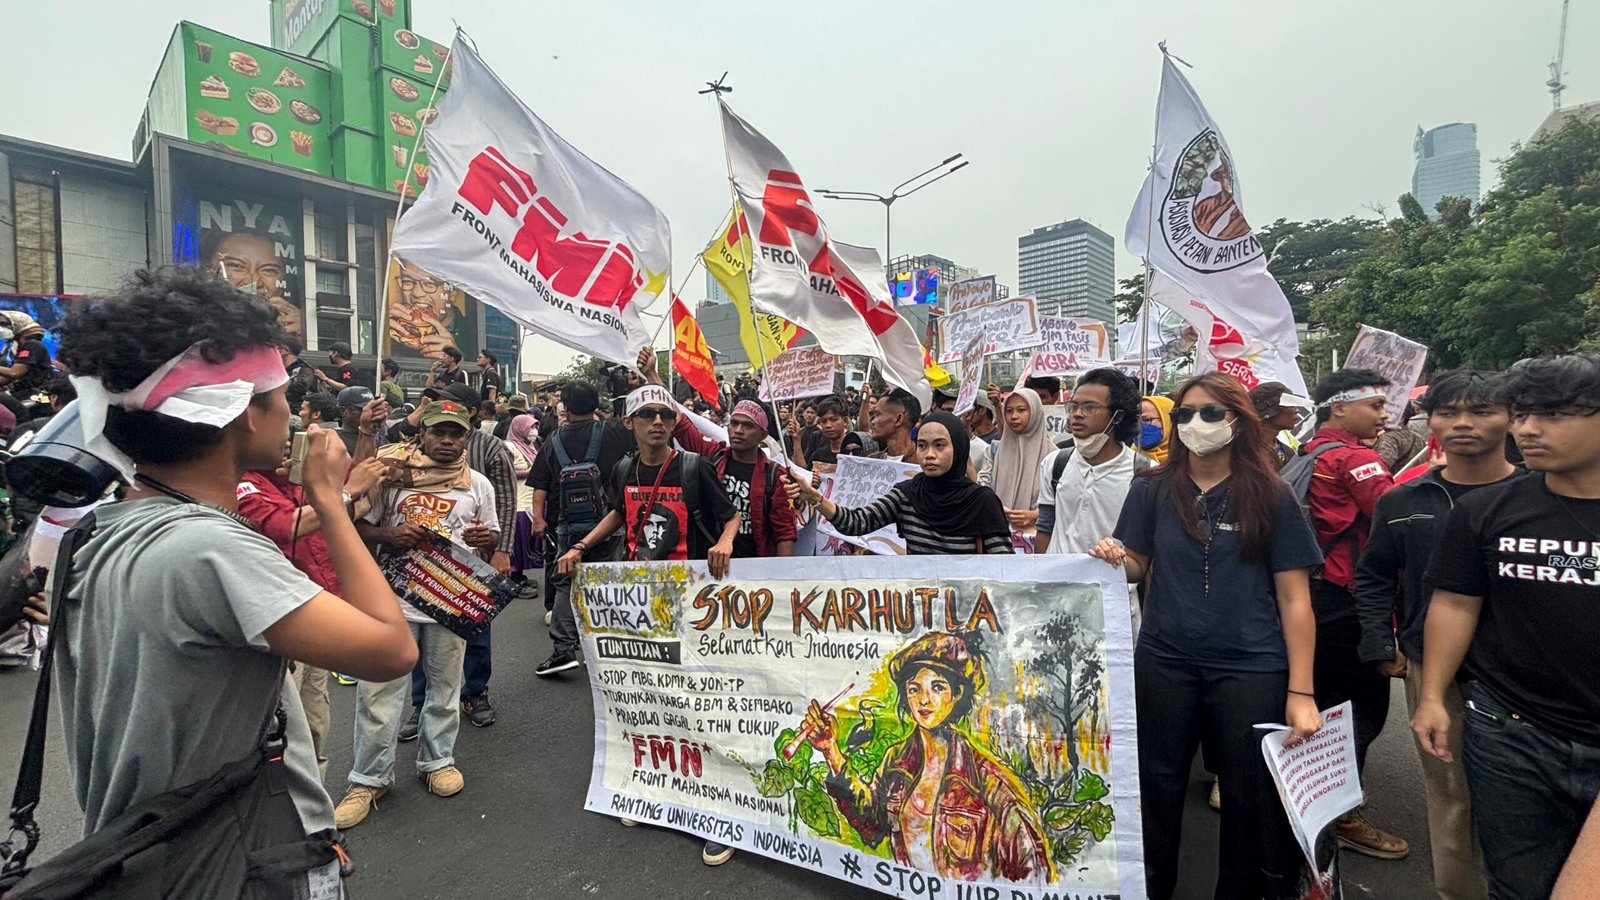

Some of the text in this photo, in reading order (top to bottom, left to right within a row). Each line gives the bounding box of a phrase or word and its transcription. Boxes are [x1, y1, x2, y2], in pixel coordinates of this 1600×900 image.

[1168, 200, 1261, 265] ASOSIASI PETANI BANTEN
[451, 201, 502, 251] FRONT
[499, 247, 575, 314] MAHASISWA
[719, 243, 746, 271] RONT
[760, 246, 807, 275] FRONT
[1053, 342, 1091, 354] RAKYAT
[1034, 352, 1080, 371] AGRA
[838, 479, 847, 491] 2
[1355, 466, 1377, 479] FMN
[405, 494, 451, 514] END
[429, 551, 492, 596] TURUNKAN HARGA
[1547, 555, 1600, 570] RAS
[404, 562, 480, 617] BIAYA PENDIDIKAN DAN
[446, 576, 467, 594] HIDUP
[584, 585, 648, 607] MALUKU
[590, 608, 657, 631] UTARA
[689, 583, 1004, 637] STOP KARHUTLA
[804, 632, 881, 661] Indonesia
[603, 670, 627, 685] STOP
[687, 676, 698, 690] &
[608, 690, 793, 715] TURUNKAN HARGA BBM & SEMBAKO
[1325, 709, 1343, 720] FMN
[616, 708, 659, 727] PRABOWO
[707, 719, 731, 734] THN
[738, 720, 780, 738] CUKUP
[630, 731, 703, 778] FMN
[1292, 751, 1304, 761] DAN
[1305, 734, 1347, 754] KEMBALIKAN
[1303, 754, 1324, 767] TANAH
[1326, 745, 1345, 757] KAUM
[1296, 762, 1330, 784] PENGGARAP
[1332, 756, 1345, 766] DAN
[1304, 775, 1328, 793] LELUHUR
[1330, 767, 1347, 779] SUKU
[632, 769, 786, 817] FRONT MAHASISWA NASIONAL
[611, 793, 663, 820] RANTING
[667, 807, 744, 843] UNIVERSITAS
[753, 828, 823, 868] INDONESIA
[874, 860, 942, 899] STOP
